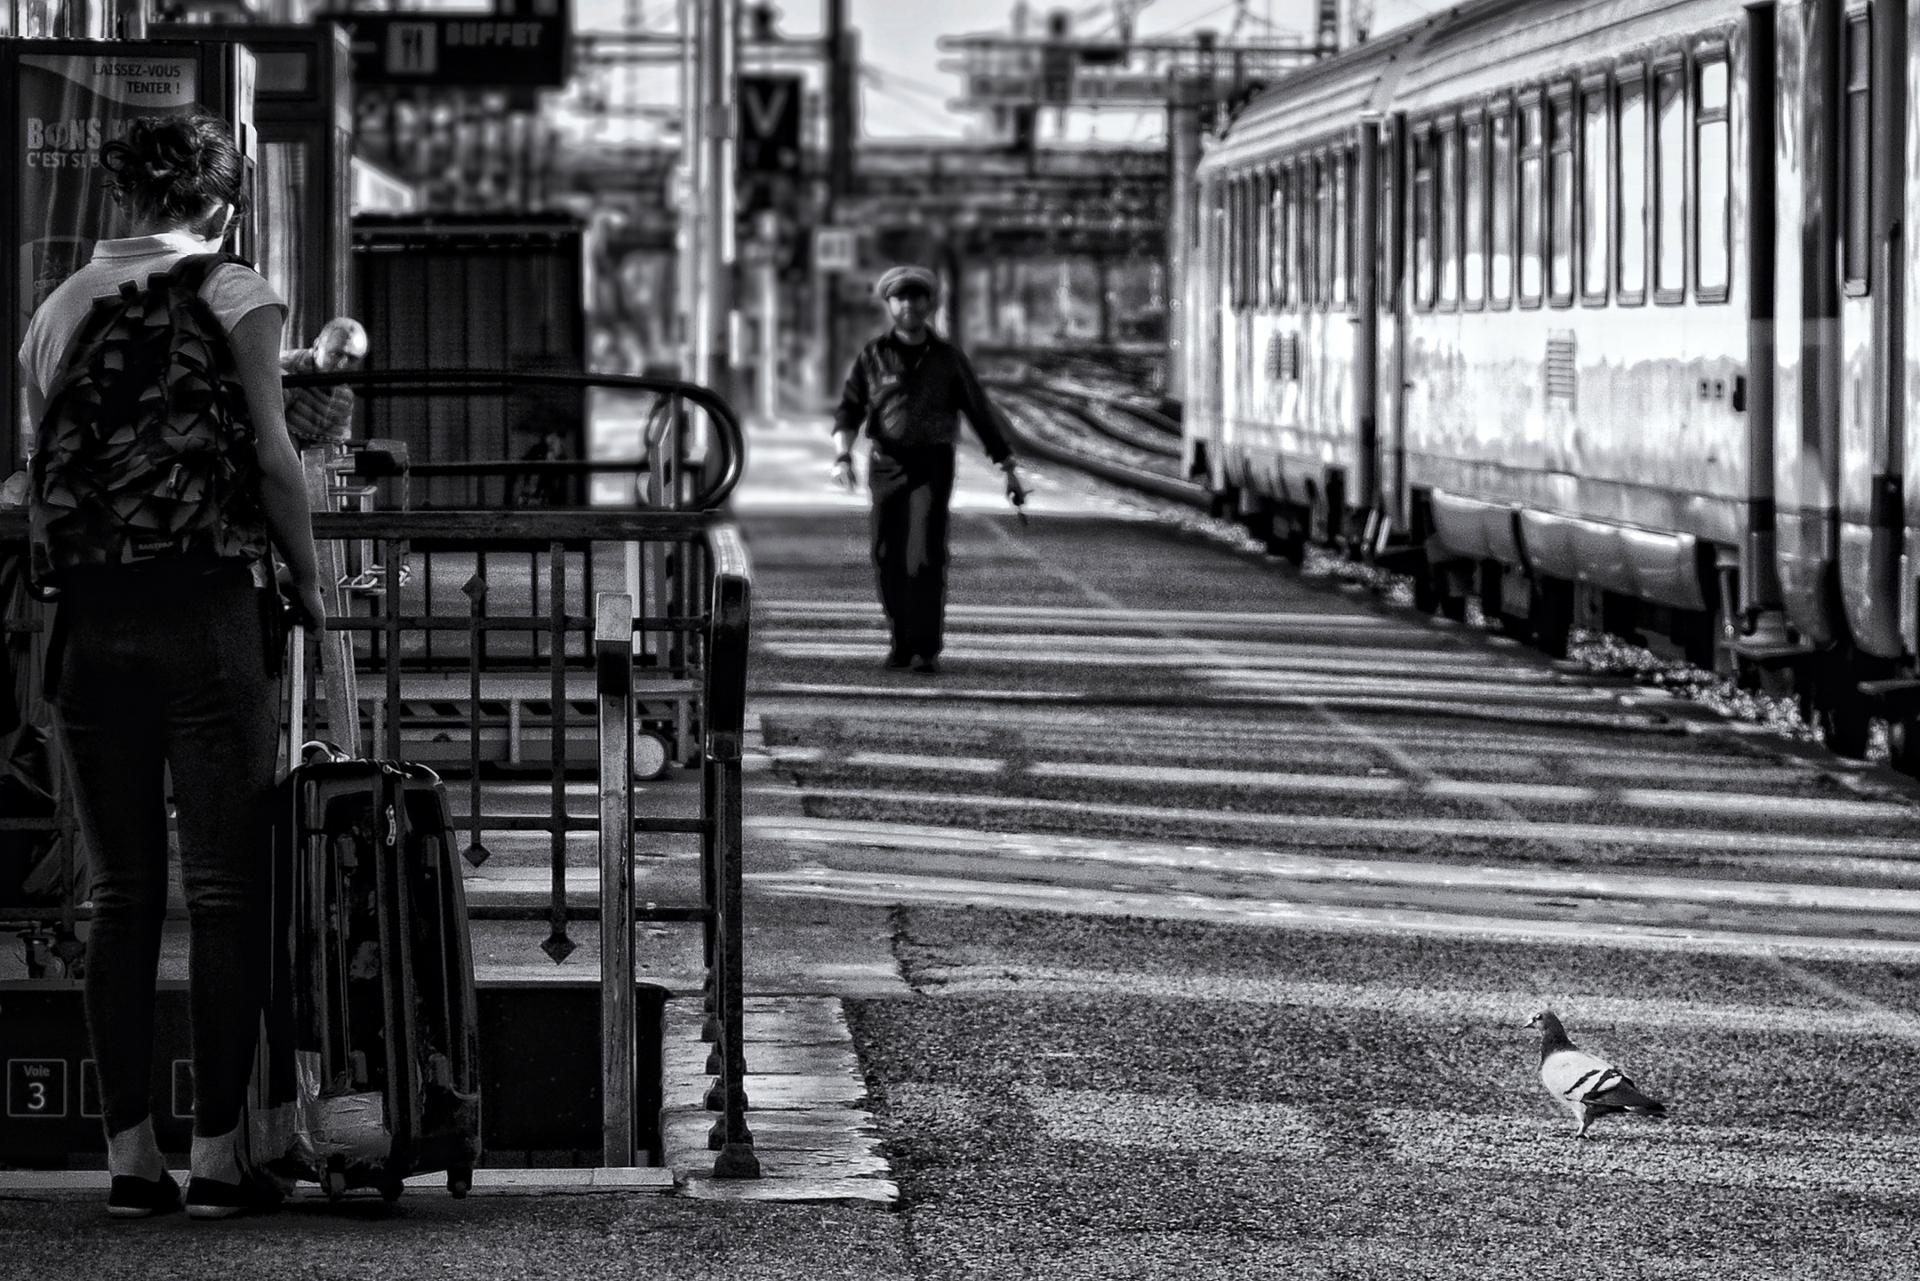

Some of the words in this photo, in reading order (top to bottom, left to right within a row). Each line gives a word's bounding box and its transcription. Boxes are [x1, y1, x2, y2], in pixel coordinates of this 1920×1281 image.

[445, 22, 543, 46] BUFFET
[92, 63, 181, 77] LAISSEZ-VOUS
[127, 81, 171, 94] TENTER
[26, 151, 68, 168] C'EST
[22, 1064, 51, 1078] Voie
[26, 1081, 46, 1110] 3
